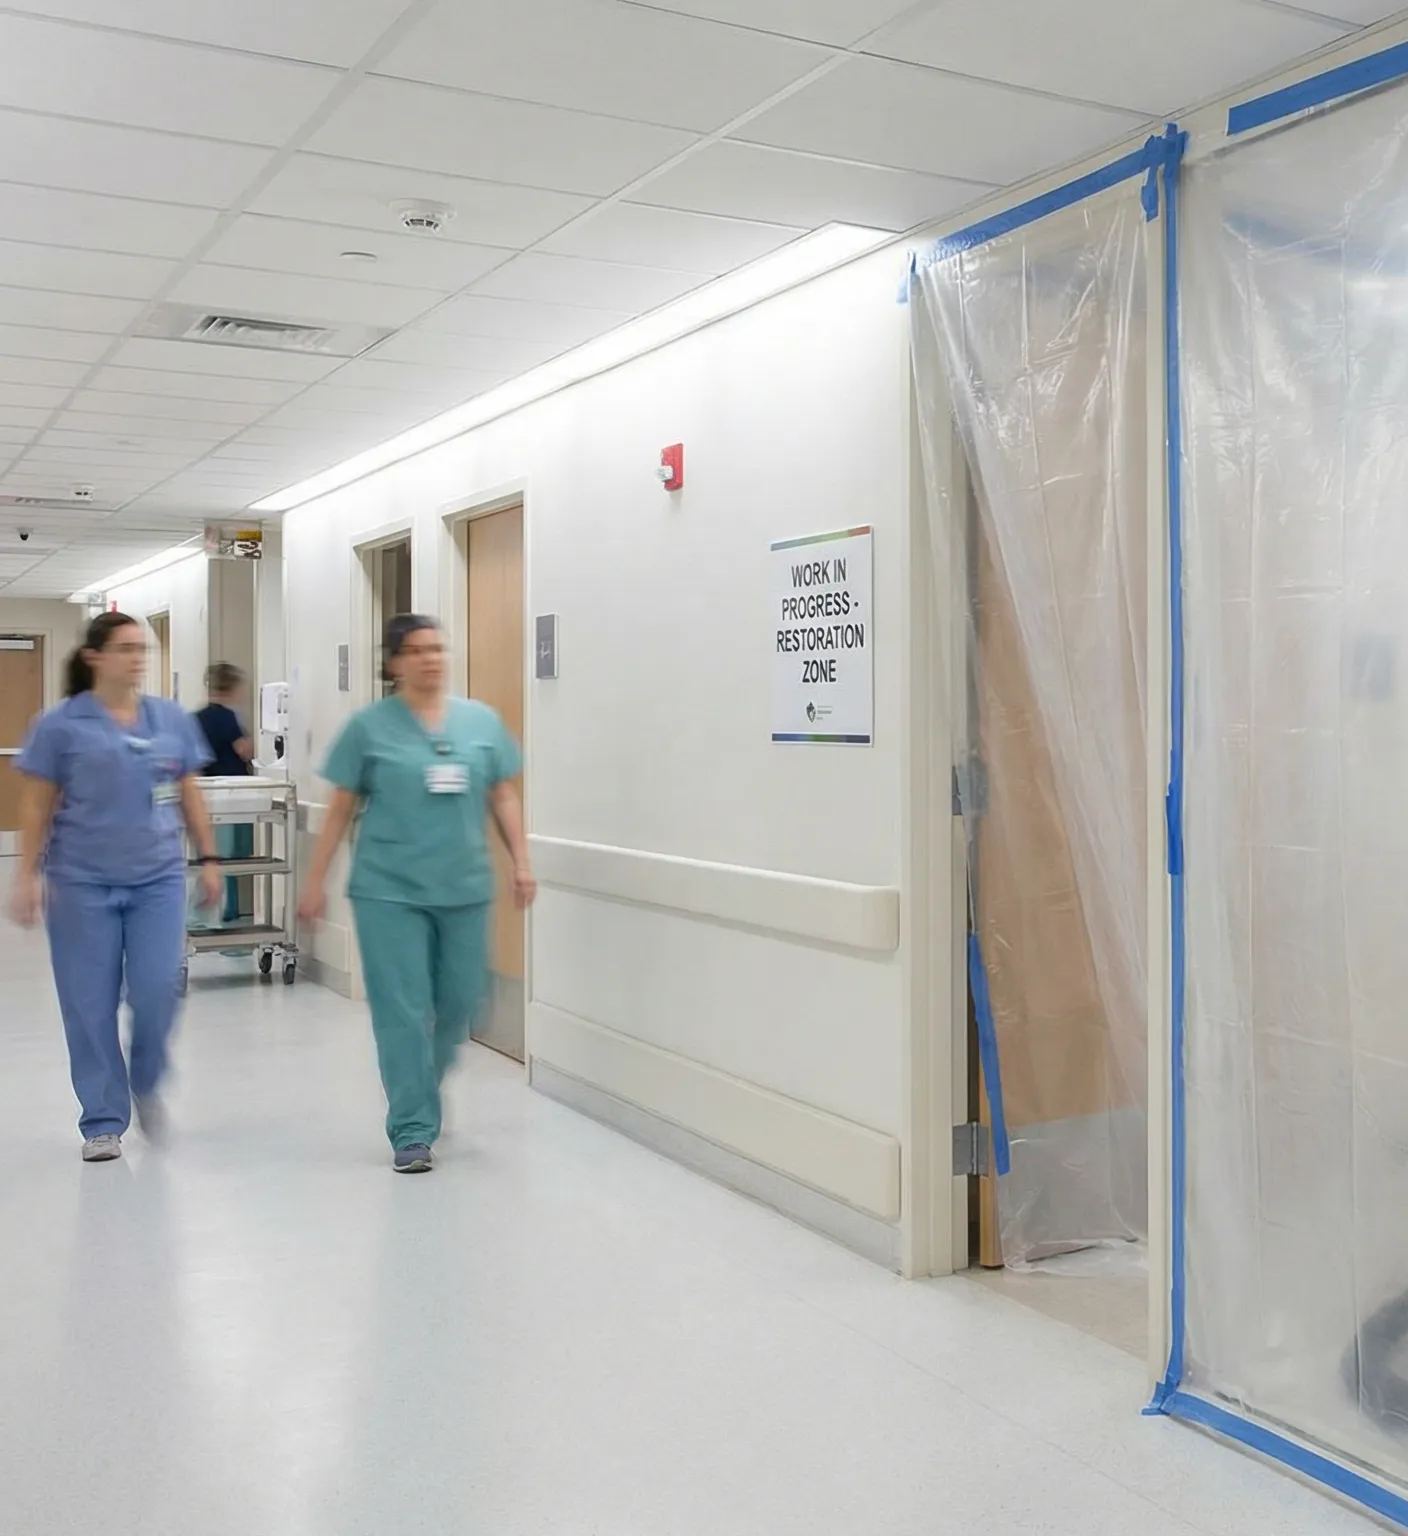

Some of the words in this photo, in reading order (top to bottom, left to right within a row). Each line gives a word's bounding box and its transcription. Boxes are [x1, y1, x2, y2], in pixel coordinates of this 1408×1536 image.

[791, 560, 830, 588] WORK
[834, 557, 847, 583] IN
[782, 590, 850, 621] PROGRESS
[777, 623, 864, 652] RESTORATION
[802, 659, 837, 683] ZONE
